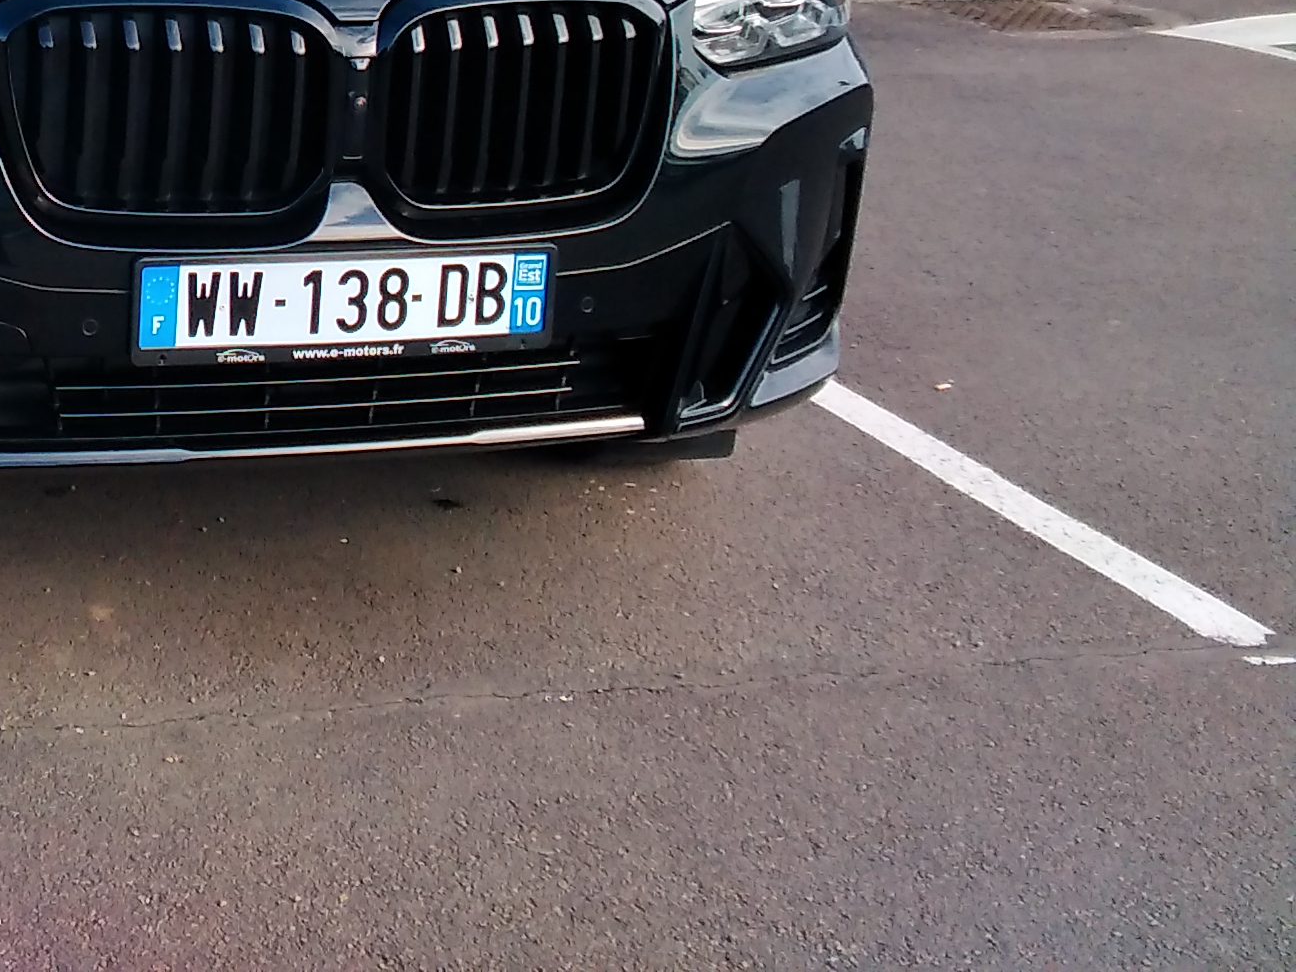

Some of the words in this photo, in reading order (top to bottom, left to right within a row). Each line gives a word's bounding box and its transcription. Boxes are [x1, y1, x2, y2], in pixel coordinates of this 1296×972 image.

[518, 269, 541, 282] Est
[514, 296, 541, 326] 10
[152, 315, 164, 334] F
[292, 344, 404, 359] www.e-motors.fr
